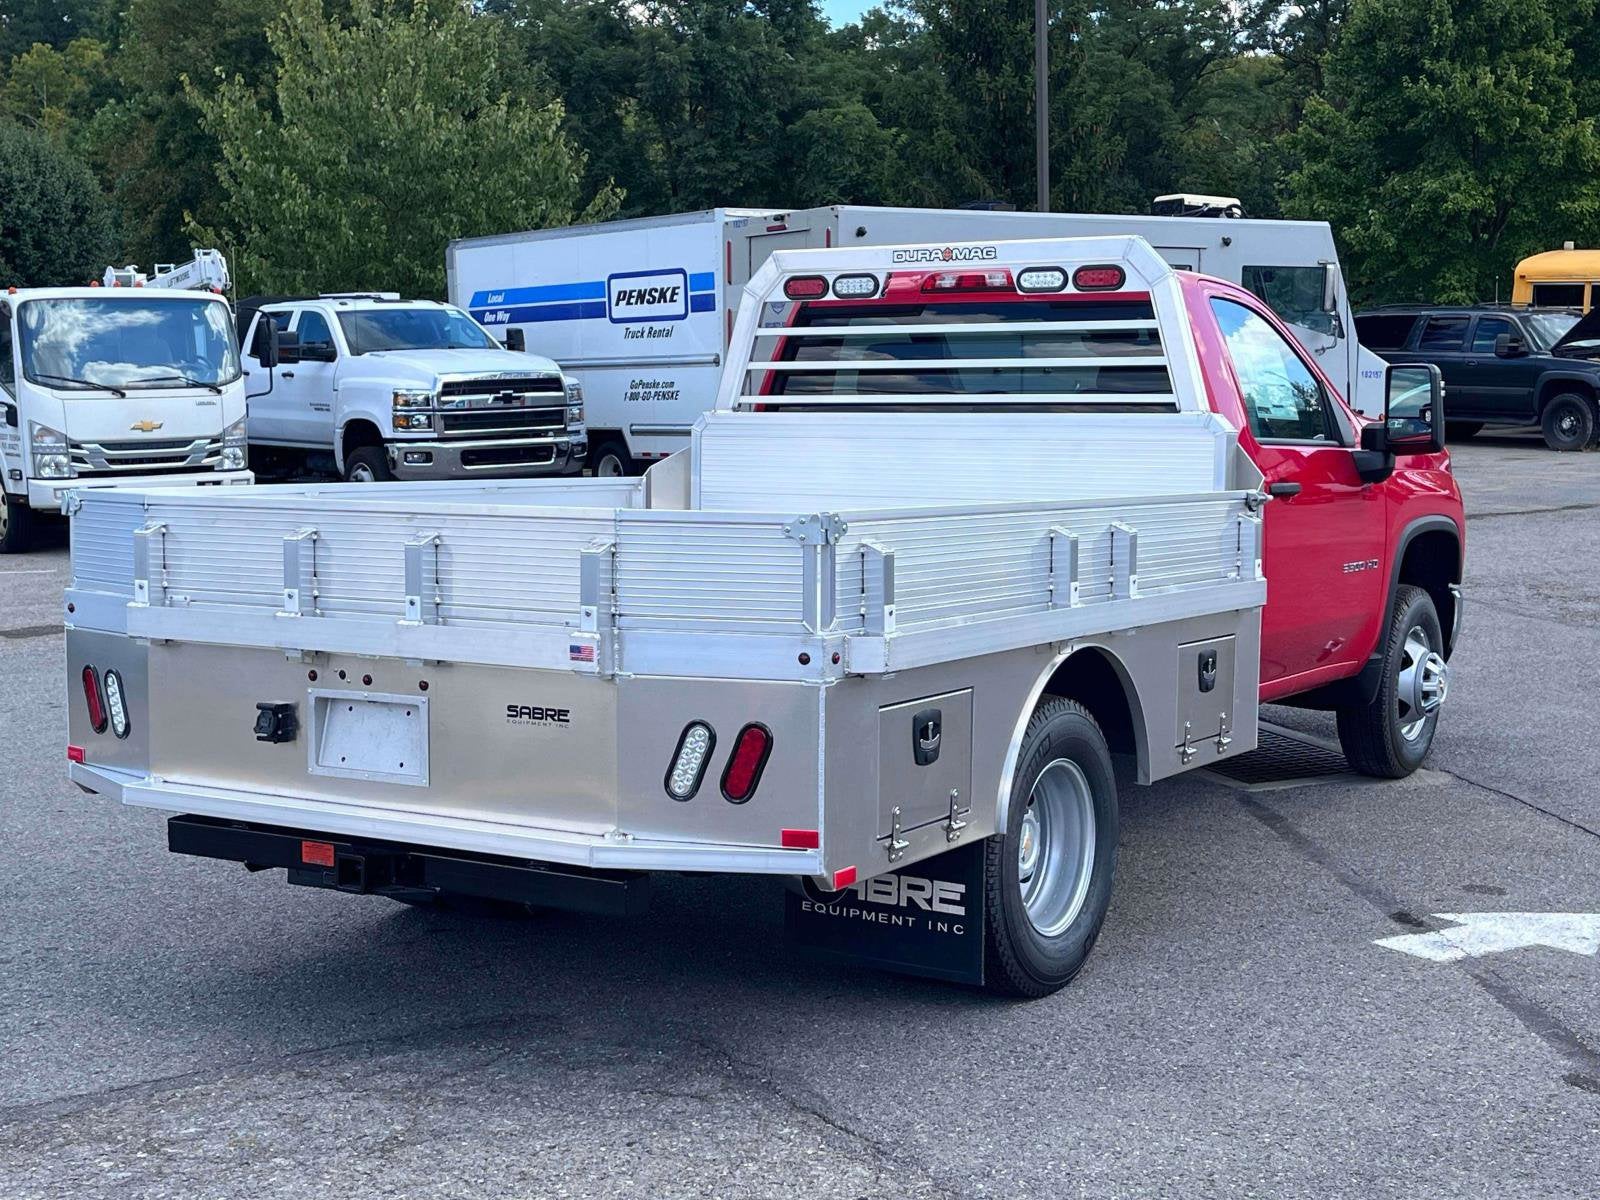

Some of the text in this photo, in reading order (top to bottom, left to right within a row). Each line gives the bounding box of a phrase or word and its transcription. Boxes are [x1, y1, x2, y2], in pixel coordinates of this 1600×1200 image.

[487, 292, 504, 304] Local
[615, 286, 680, 306] PENSKE
[483, 310, 511, 324] One Way
[624, 325, 674, 339] Truck Rental
[630, 379, 675, 390] GoPenske.com
[624, 390, 680, 402] 1-800-GO-PENSKE
[507, 705, 570, 722] SABRE
[506, 719, 551, 727] EQUIPMENT
[848, 873, 966, 916] BRE
[801, 900, 965, 935] EQUIPMENT INC
